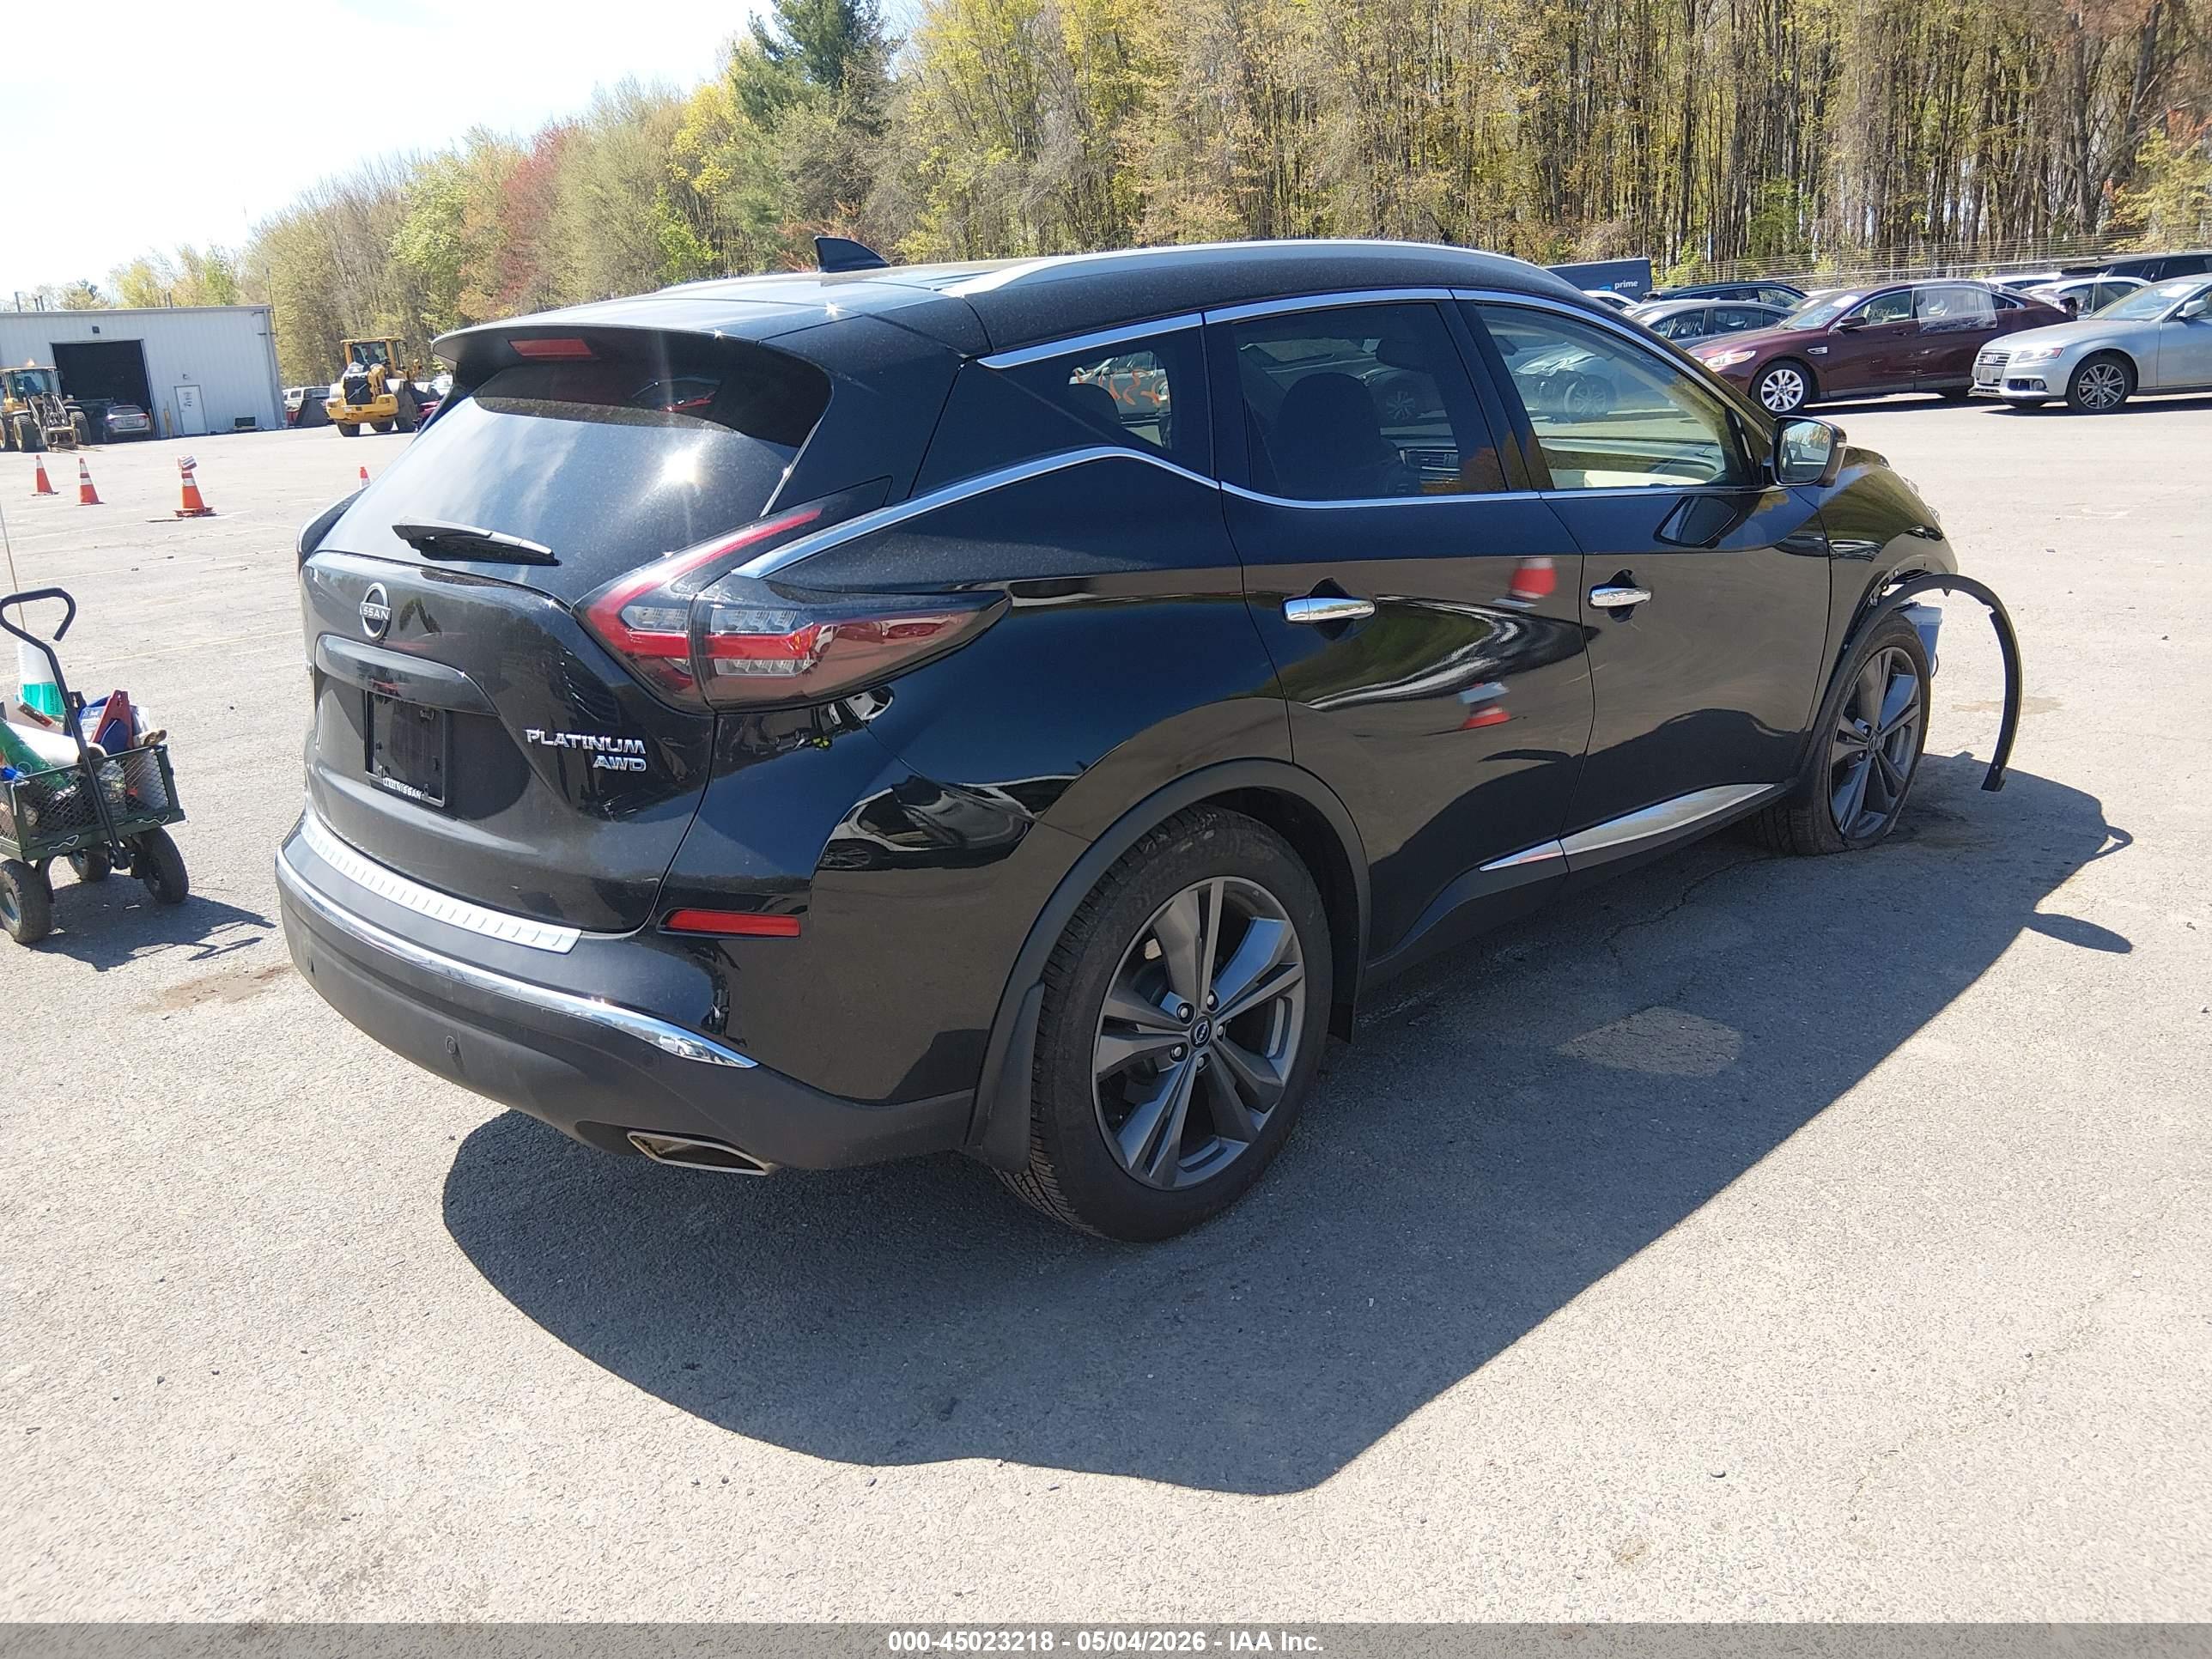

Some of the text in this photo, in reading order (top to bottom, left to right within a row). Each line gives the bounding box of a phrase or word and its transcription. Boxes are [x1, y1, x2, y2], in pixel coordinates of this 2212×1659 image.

[1614, 280, 1638, 290] prime
[361, 604, 389, 620] SSAN
[526, 728, 646, 754] PLATINUM
[592, 755, 647, 772] AWD
